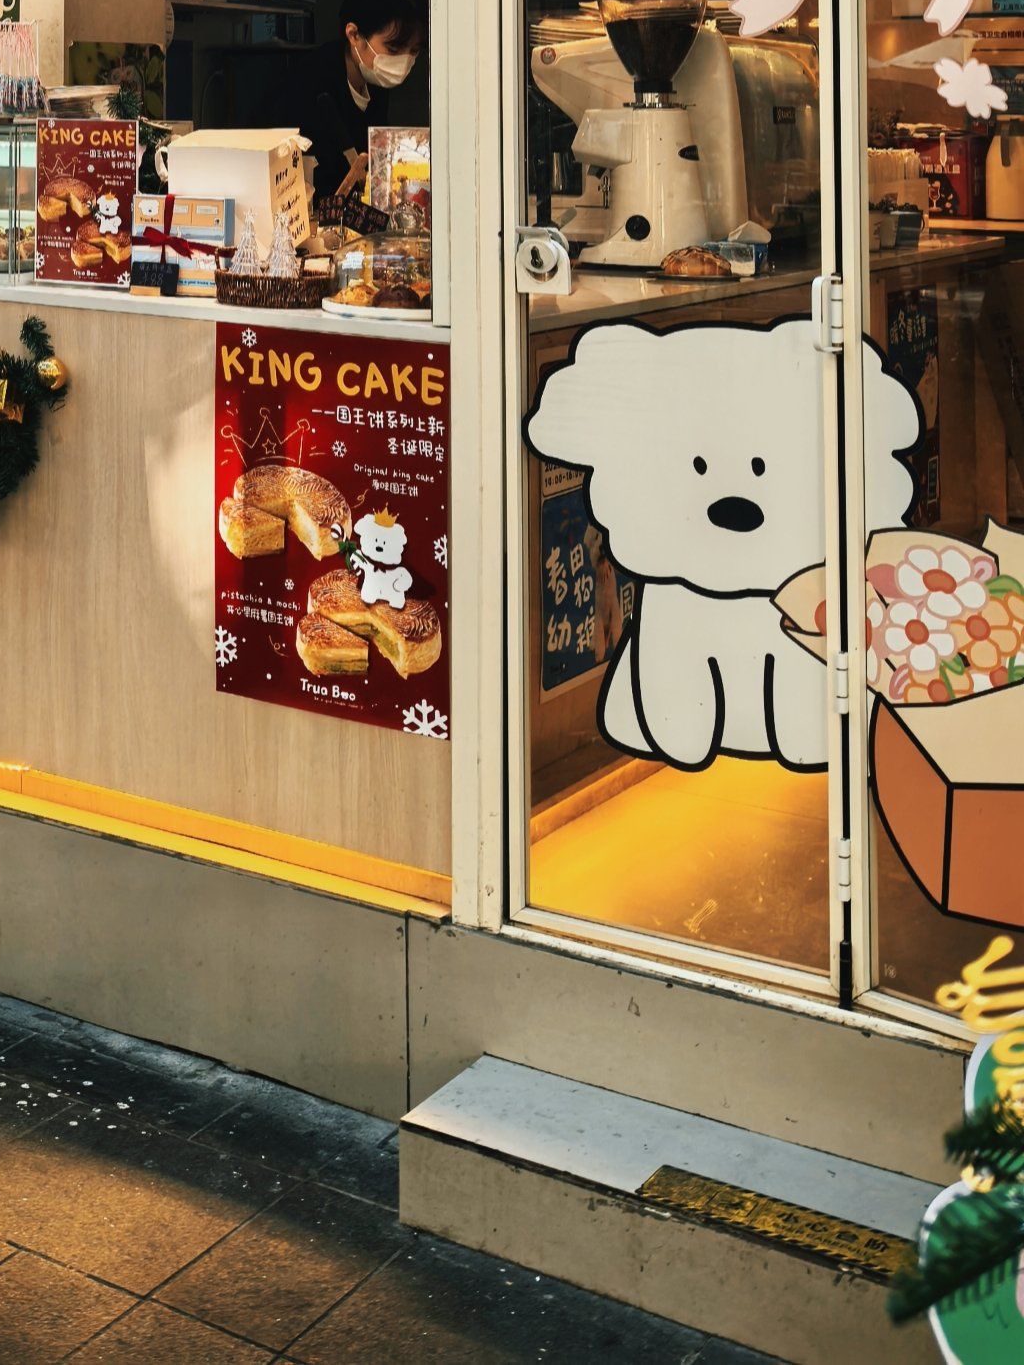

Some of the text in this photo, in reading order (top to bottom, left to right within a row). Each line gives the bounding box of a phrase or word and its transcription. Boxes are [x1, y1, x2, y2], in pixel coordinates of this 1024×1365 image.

[38, 127, 135, 147] KING CAKE
[221, 345, 444, 405] KING CAKE
[387, 438, 444, 462] 圣诞限定
[354, 463, 388, 477] Original
[415, 472, 435, 483] cake
[372, 478, 419, 497] 原味国王饼
[221, 591, 263, 605] pistachio
[276, 600, 301, 611] mochi
[300, 678, 328, 696] Trua
